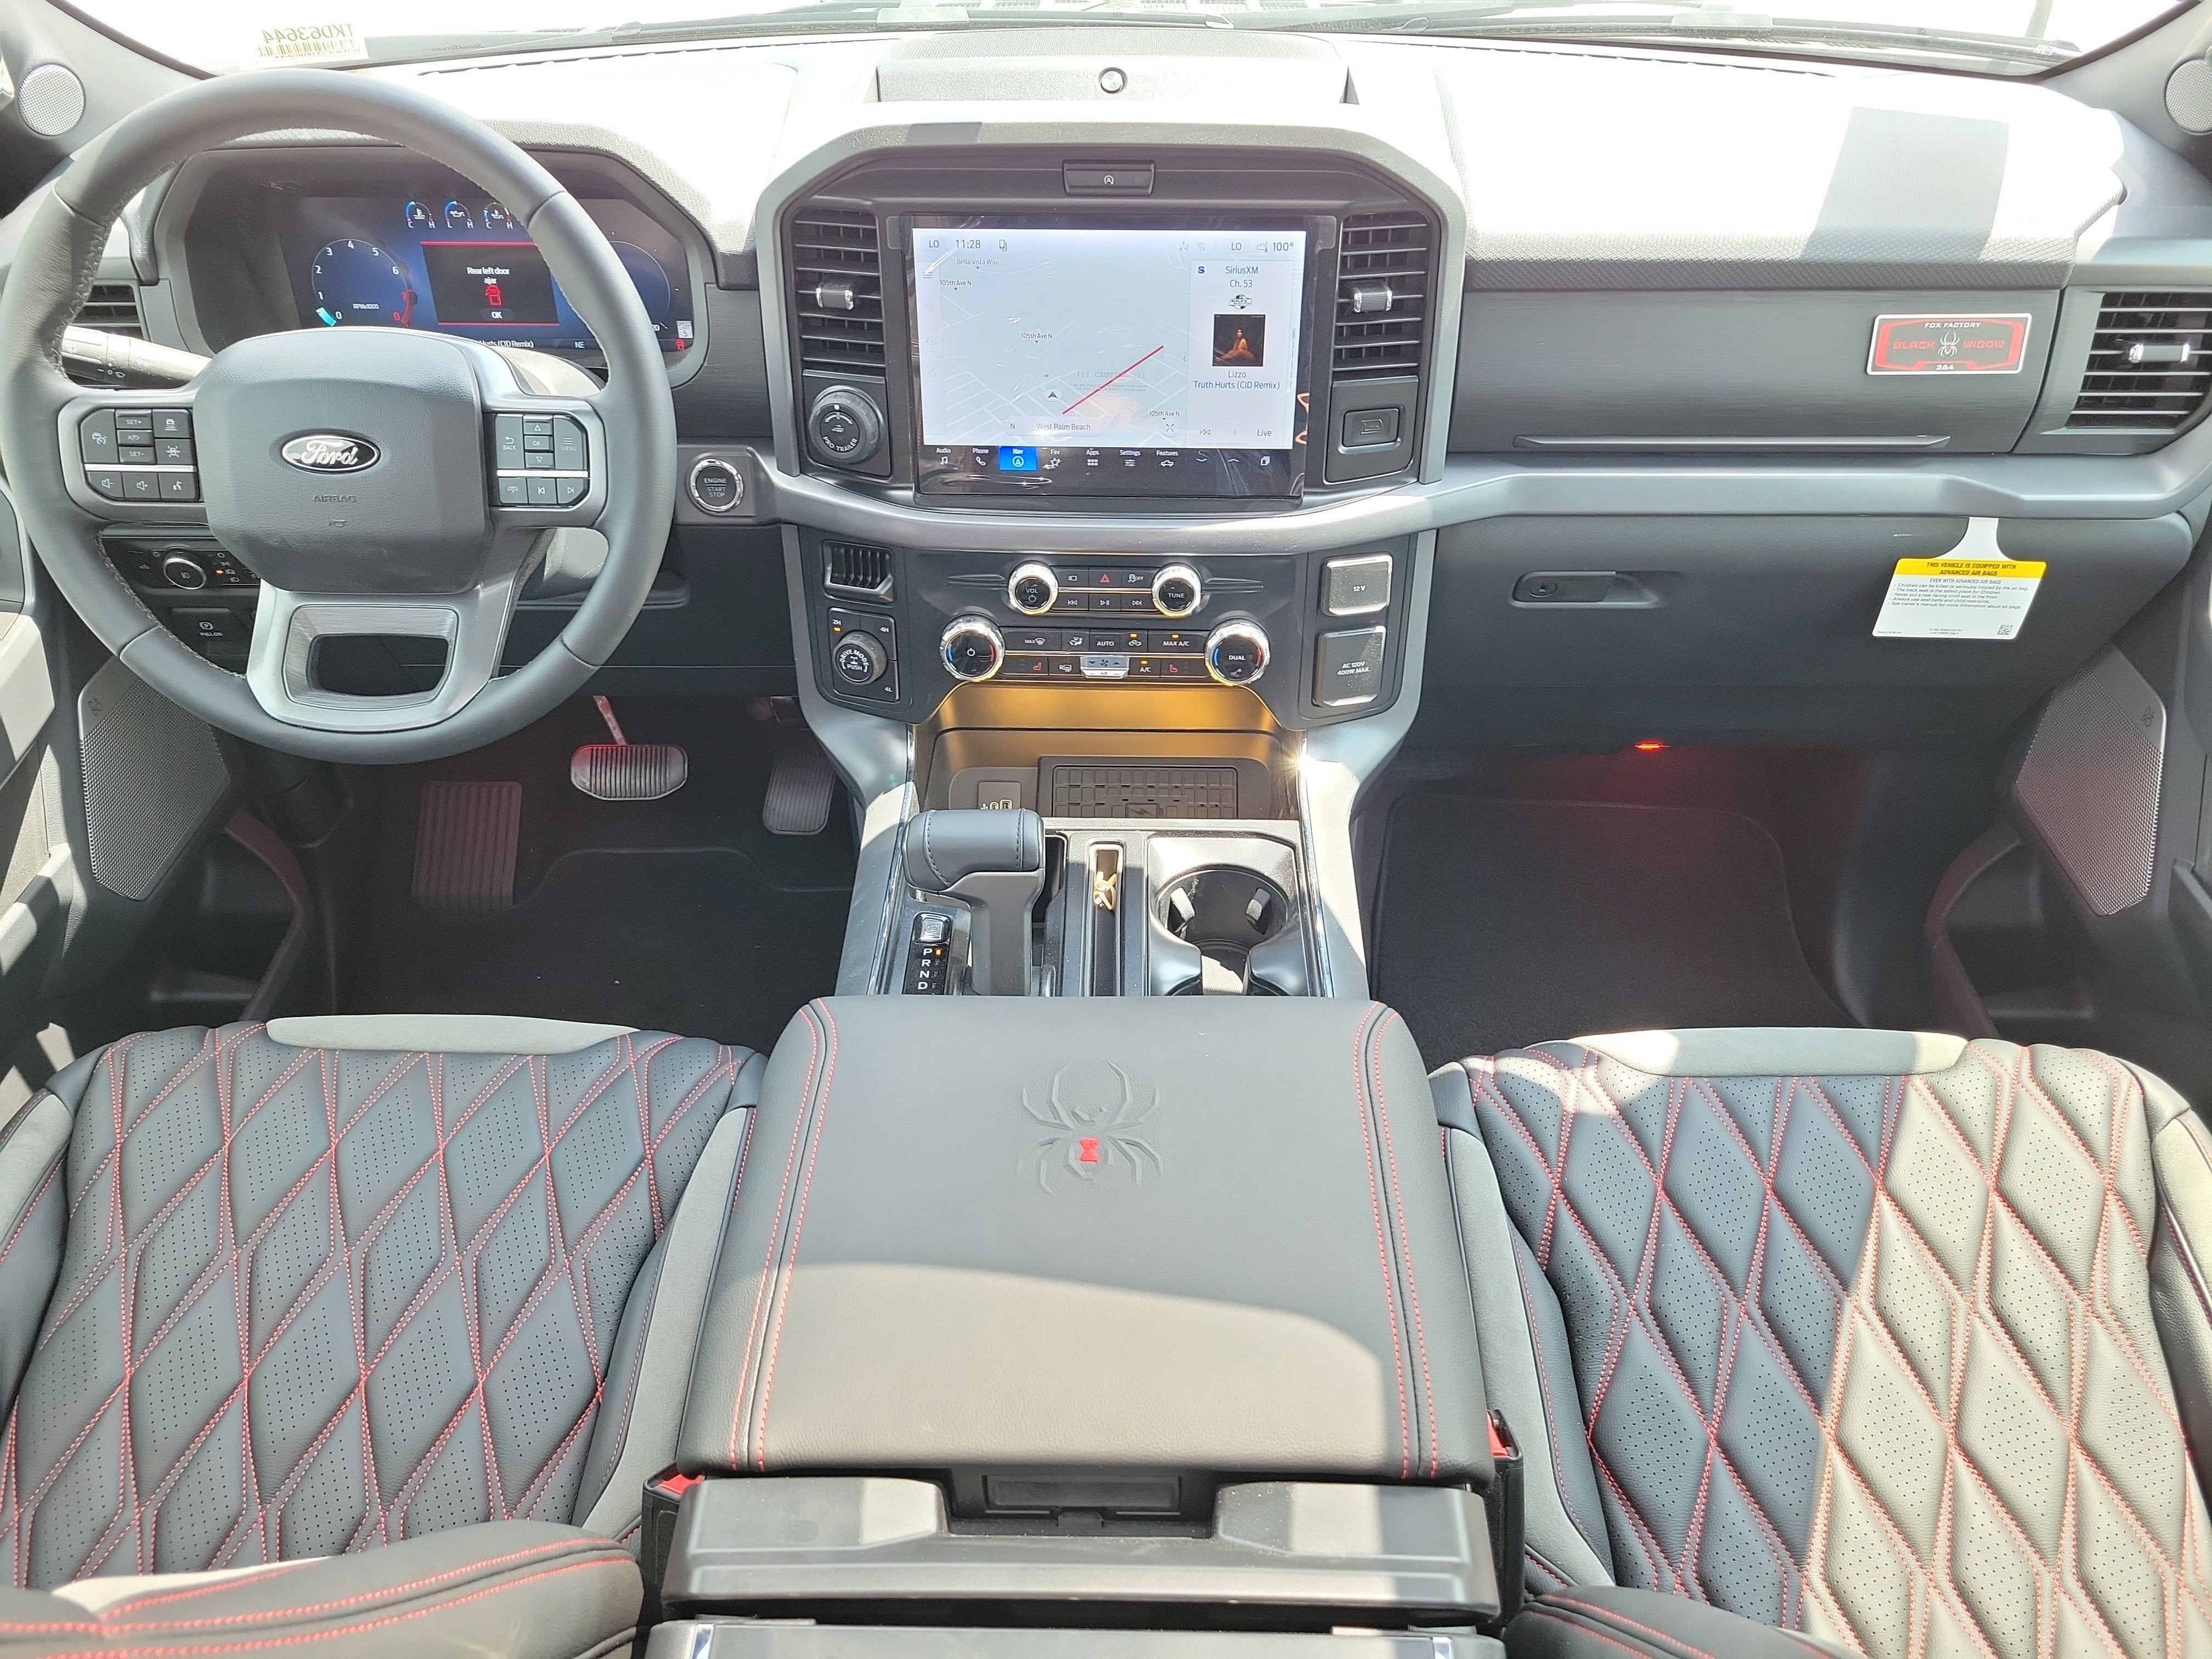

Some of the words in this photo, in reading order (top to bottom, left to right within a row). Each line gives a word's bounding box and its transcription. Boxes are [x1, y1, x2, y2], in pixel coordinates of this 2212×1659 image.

[955, 240, 981, 249] 11:28
[1273, 242, 1294, 251] 100°
[326, 247, 332, 256] 3
[372, 247, 379, 256] 5
[315, 266, 322, 274] 2
[392, 266, 399, 274] 6
[1226, 266, 1259, 274] SiriusXM
[484, 276, 497, 285] ajar
[318, 291, 323, 300] 1
[335, 311, 342, 319] 0
[1893, 340, 1935, 349] BLACK
[1963, 340, 2004, 348] WIDOW
[1193, 380, 1214, 389] Truth
[1215, 381, 1235, 389] Hurts
[1237, 381, 1252, 391] (CID
[1254, 381, 1280, 391] Remix)
[823, 436, 834, 449] PRO
[836, 438, 858, 452] TRAILER
[301, 440, 358, 465] Ford
[839, 649, 853, 663] DRIVE
[853, 650, 869, 665] MODE
[921, 959, 931, 967] R
[919, 970, 930, 978] N
[917, 981, 928, 990] D
